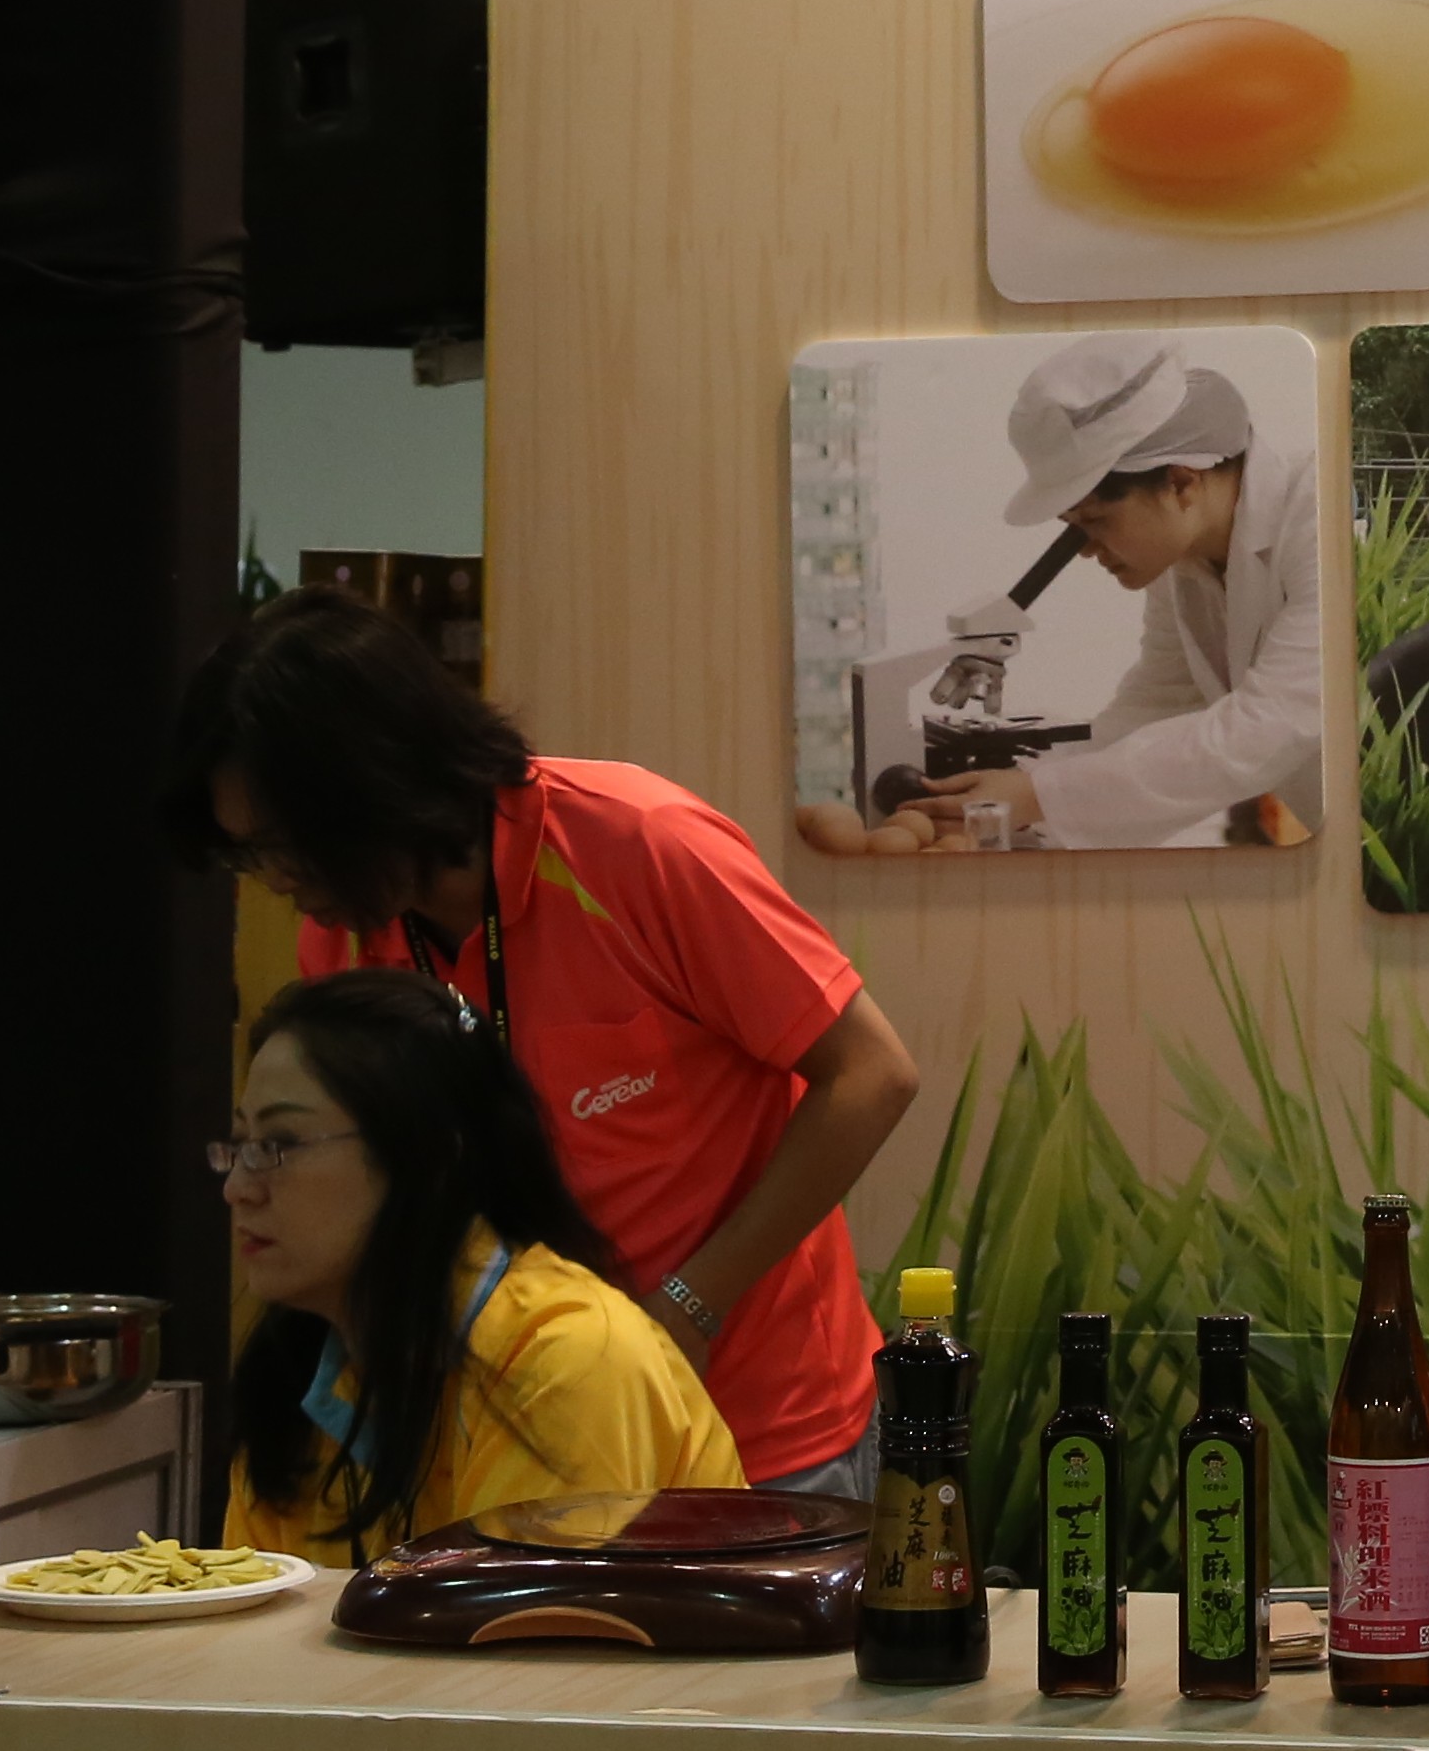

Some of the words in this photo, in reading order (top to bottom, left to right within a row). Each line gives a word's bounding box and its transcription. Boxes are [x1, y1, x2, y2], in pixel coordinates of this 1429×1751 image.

[1356, 1478, 1391, 1613] 紅標料理米酒
